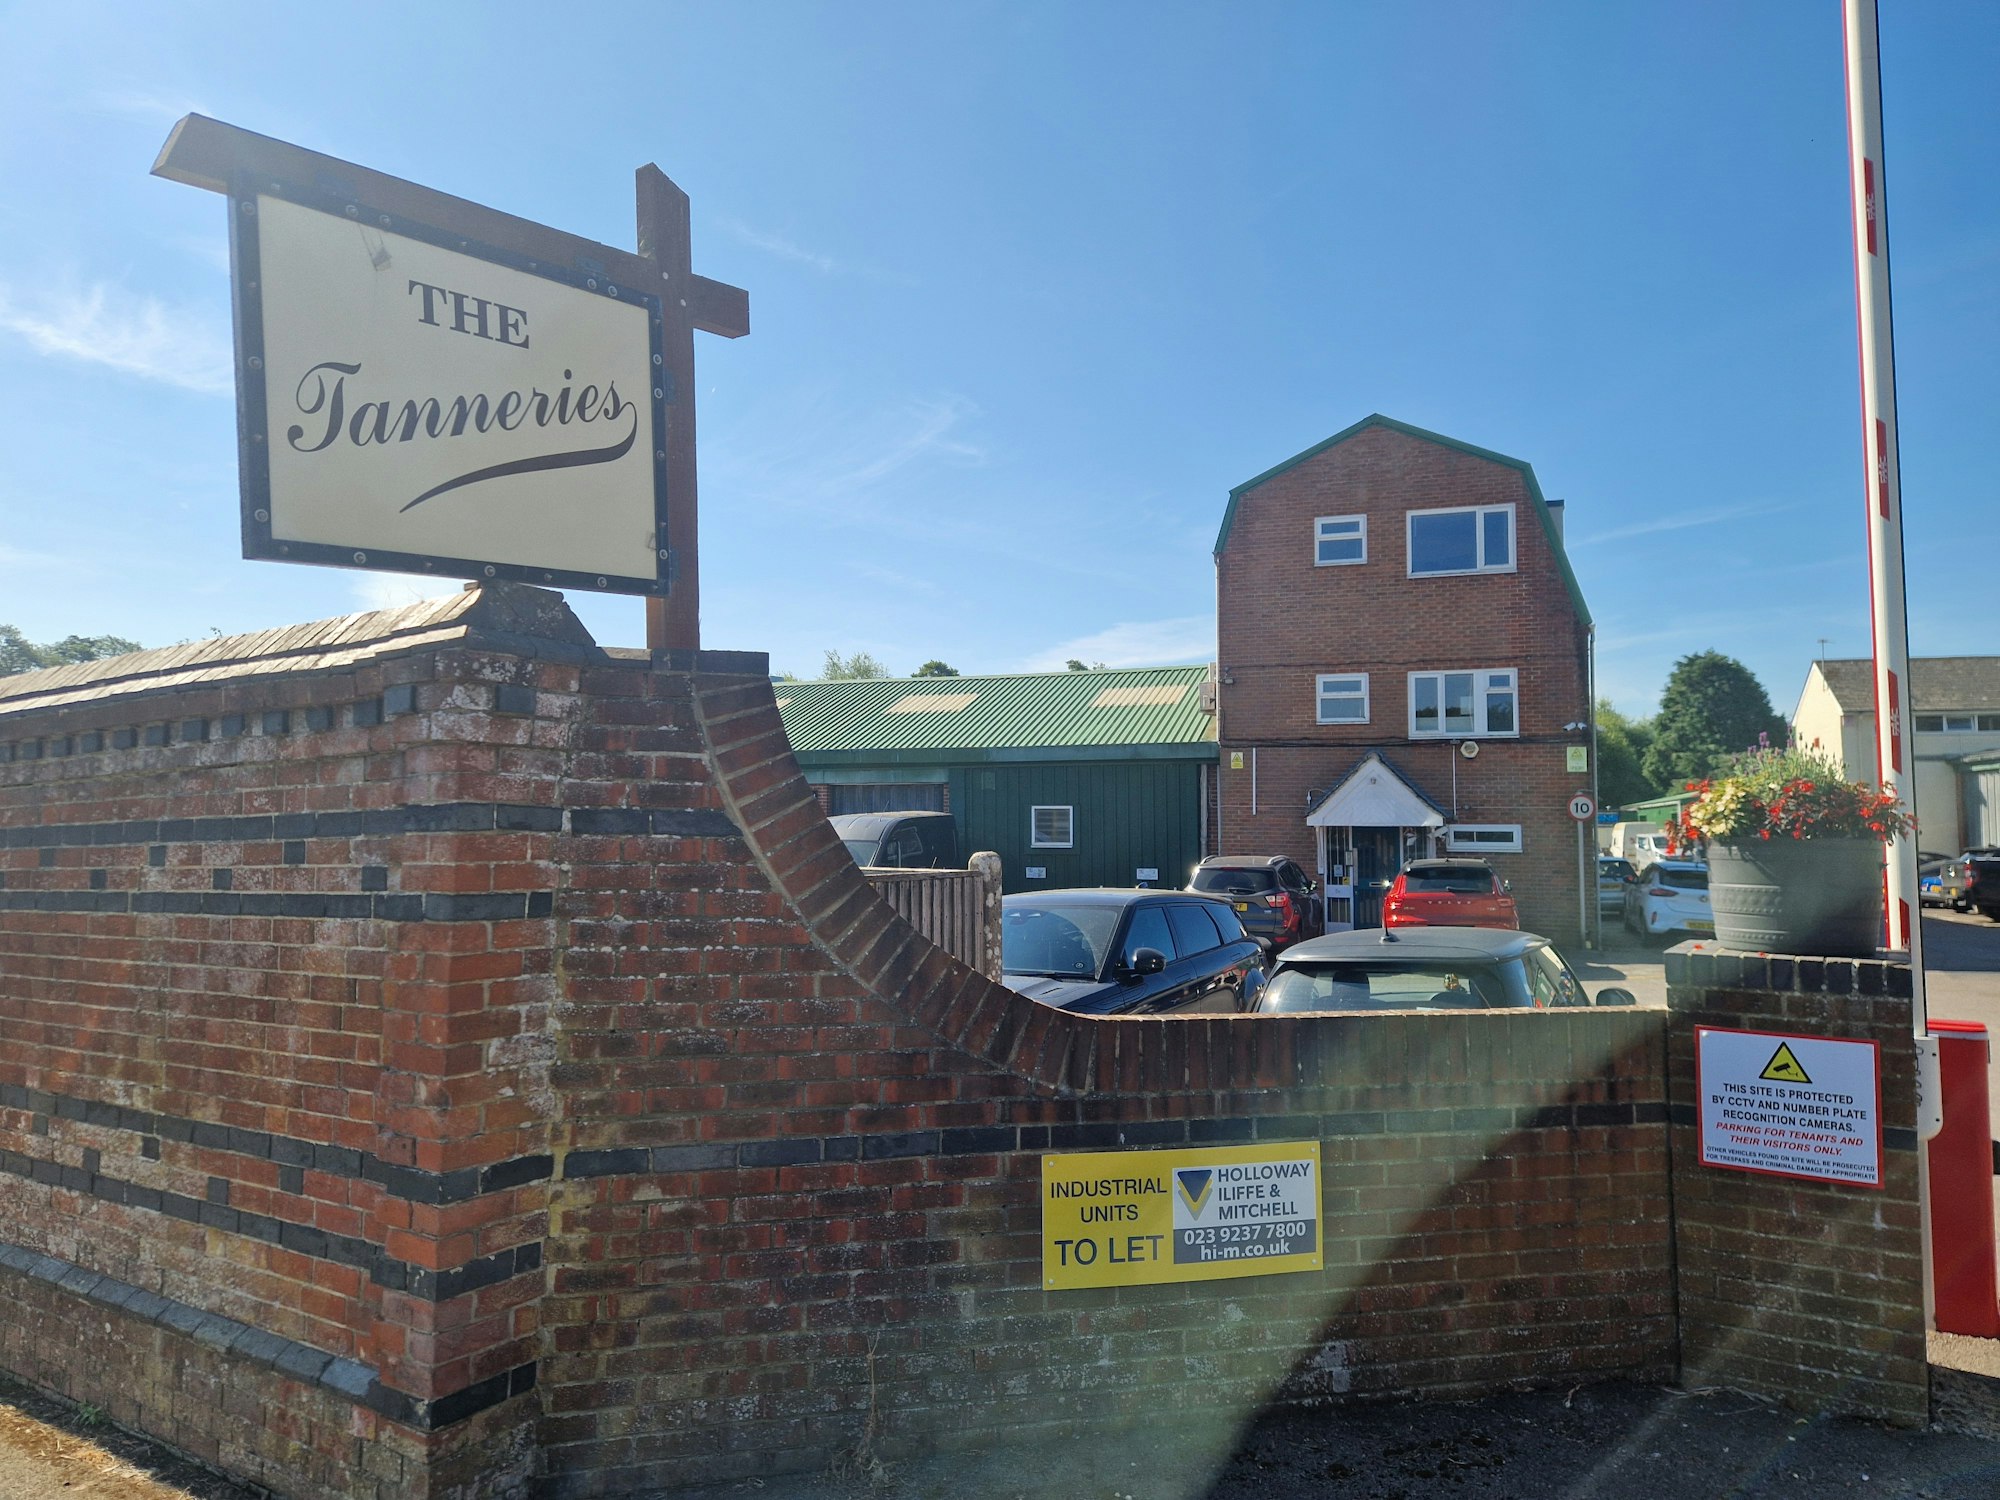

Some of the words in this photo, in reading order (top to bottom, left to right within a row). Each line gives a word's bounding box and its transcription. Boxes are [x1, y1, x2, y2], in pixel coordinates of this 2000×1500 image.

[408, 279, 530, 349] THE
[287, 361, 638, 453] Tanneries
[1574, 802, 1590, 814] 10
[1723, 1083, 1747, 1094] THIS
[1749, 1085, 1772, 1097] SITE
[1776, 1088, 1786, 1098] IS
[1788, 1089, 1854, 1105] PROTECTED
[1712, 1095, 1725, 1104] BY
[1728, 1096, 1755, 1108] CCTV
[1758, 1100, 1780, 1110] AND
[1783, 1102, 1830, 1116] NUMBER
[1833, 1107, 1867, 1120] PLATE
[1723, 1109, 1796, 1126] RECOGNITION
[1799, 1118, 1856, 1133] CAMERAS.
[1716, 1121, 1761, 1134] PARKING
[1764, 1127, 1786, 1138] FOR
[1789, 1130, 1837, 1143] TENANTS
[1840, 1137, 1863, 1147] AND
[1730, 1135, 1760, 1146] THEIR
[1763, 1138, 1811, 1152] VISITORS
[1813, 1145, 1842, 1156] ONLY.
[1706, 1145, 1727, 1153] OTHER
[1728, 1149, 1757, 1157] VEHICLES
[1758, 1152, 1779, 1160] FOUND
[1791, 1156, 1805, 1164] SITE
[1832, 1161, 1875, 1172] PROSECUTED
[1720, 1155, 1750, 1164] TRESPASS
[1765, 1160, 1795, 1170] CRIMINAL
[1796, 1165, 1823, 1174] DAMAGE
[1831, 1169, 1875, 1180] APPROPRIATE
[1218, 1162, 1310, 1182] HOLLOWAY
[1051, 1177, 1168, 1199] INDUSTRIAL
[1218, 1184, 1265, 1201] ILIFFE
[1269, 1183, 1281, 1197] &
[1080, 1204, 1139, 1223] UNITS
[1218, 1201, 1298, 1220] MITCHELL
[1184, 1228, 1216, 1245] 023
[1220, 1225, 1262, 1243] 9237
[1265, 1221, 1306, 1239] 7800
[1054, 1238, 1097, 1266] TO
[1109, 1234, 1164, 1263] LET
[1200, 1238, 1290, 1260] hi-m.co.uk
